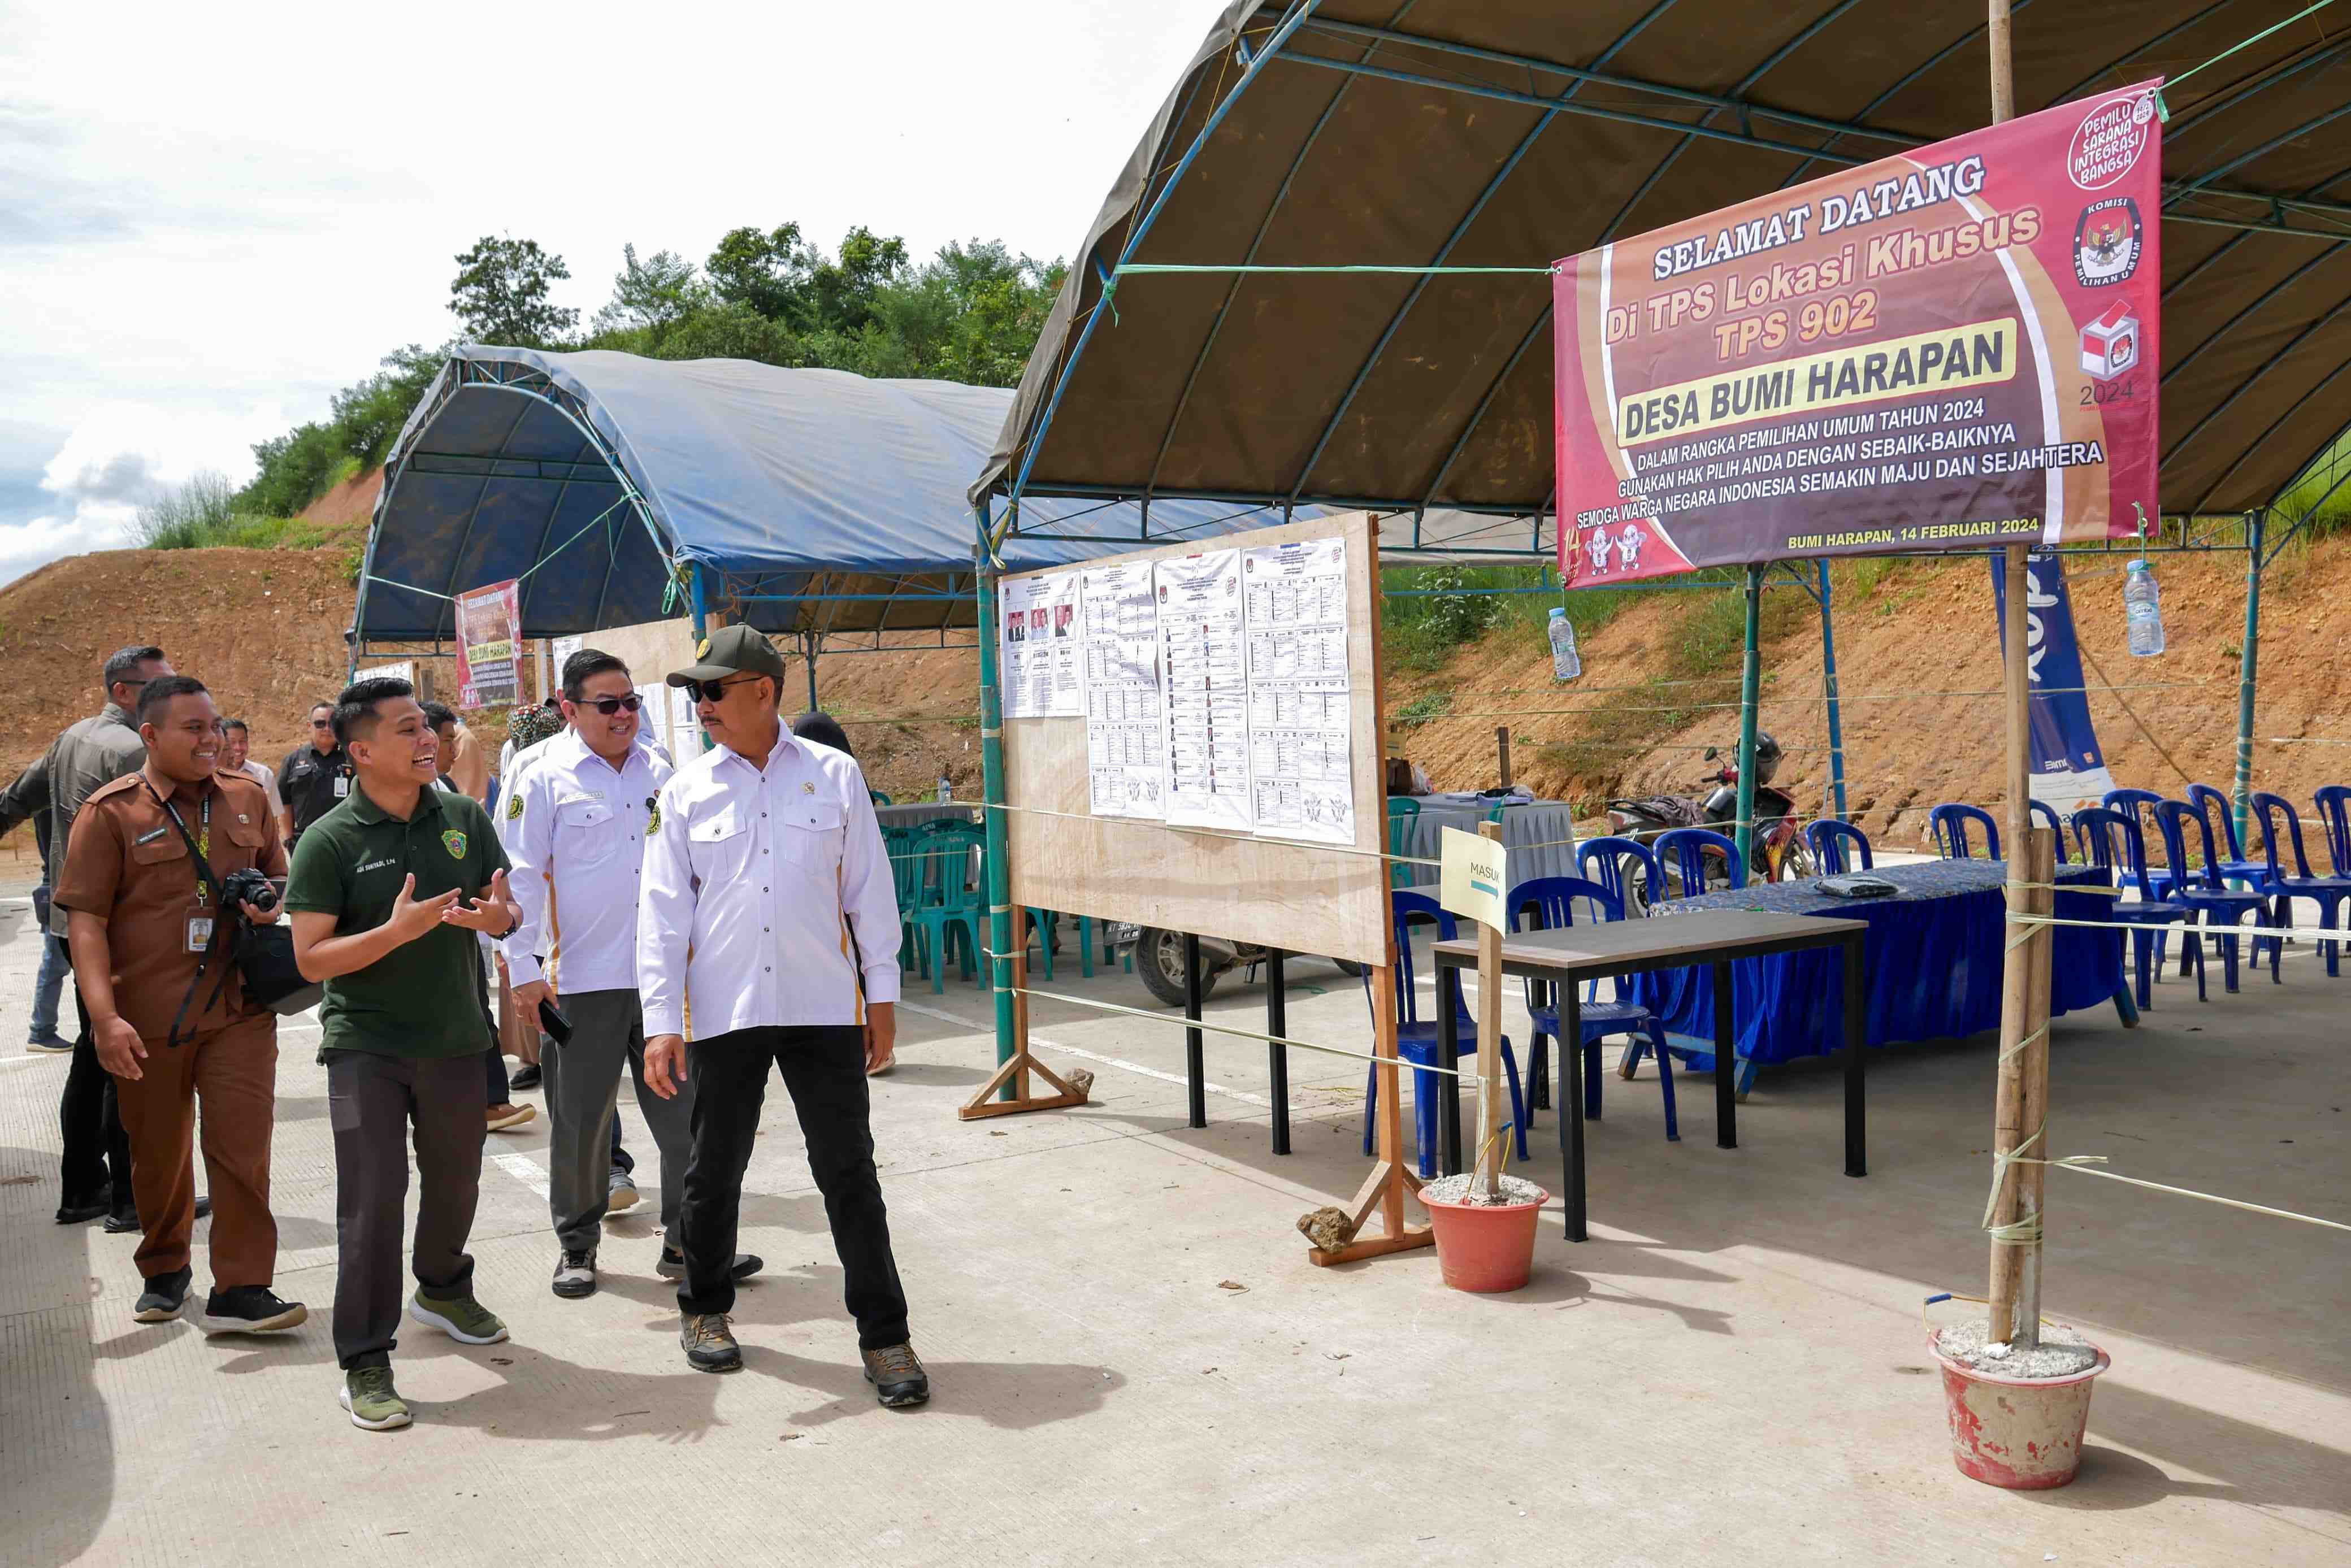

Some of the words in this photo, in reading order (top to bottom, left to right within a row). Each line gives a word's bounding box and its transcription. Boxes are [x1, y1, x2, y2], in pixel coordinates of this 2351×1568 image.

[2083, 118, 2132, 154] SARANA
[2084, 103, 2131, 137] PEMILU
[2075, 131, 2139, 172] INTEGRASI
[2081, 149, 2132, 184] BANGSA
[1654, 205, 1811, 280] SELAMAT
[1820, 156, 1986, 234] DATANG
[2088, 198, 2128, 214] KOMISI
[1607, 303, 1638, 344] Di
[1647, 283, 1715, 332] TPS
[1724, 243, 1855, 313] Lokasi
[1866, 208, 2041, 279] Khusus
[2074, 254, 2118, 286] PEMILIHAN
[2122, 242, 2141, 279] UMUM
[1715, 310, 1788, 362] TPS
[1799, 289, 1877, 342] 902
[1626, 390, 1699, 438] DESA
[1710, 369, 1794, 420] BUMI
[1807, 330, 2003, 402] HARAPAN
[2080, 380, 2134, 405] 2024
[1638, 448, 1678, 471] DALAM
[1681, 436, 1736, 459] RANGKA
[1738, 421, 1818, 451] PEMILIHAN
[1823, 414, 1874, 438] UMUM
[1880, 404, 1938, 431] TAHUN
[1942, 397, 1984, 422] 2024
[1618, 472, 1674, 498] GUNAKAN
[1677, 468, 1703, 487] HAK
[1706, 459, 1739, 482] PILIH
[1741, 453, 1782, 475] ANDA
[1786, 441, 1855, 468] DENGAN
[1860, 423, 2016, 461] SEBAIK-BAIKNYA
[1577, 506, 1619, 529] SEMOGA
[1620, 497, 1663, 521] WARGA
[1665, 489, 1716, 514] NEGARA
[1719, 476, 1796, 503] INDONESIA
[1799, 465, 1876, 493] SEMAKIN
[1881, 461, 1930, 485] MAJU
[1935, 456, 1976, 479] DAN
[1981, 441, 2103, 475] SEJAHTERA
[1788, 535, 1822, 550] BUMI
[1827, 528, 1895, 546] HARAPAN,
[1900, 527, 1917, 541] 14
[1921, 521, 1996, 540] FEBRUARI
[2001, 518, 2039, 533] 2024
[1471, 862, 1500, 884] MASUK
